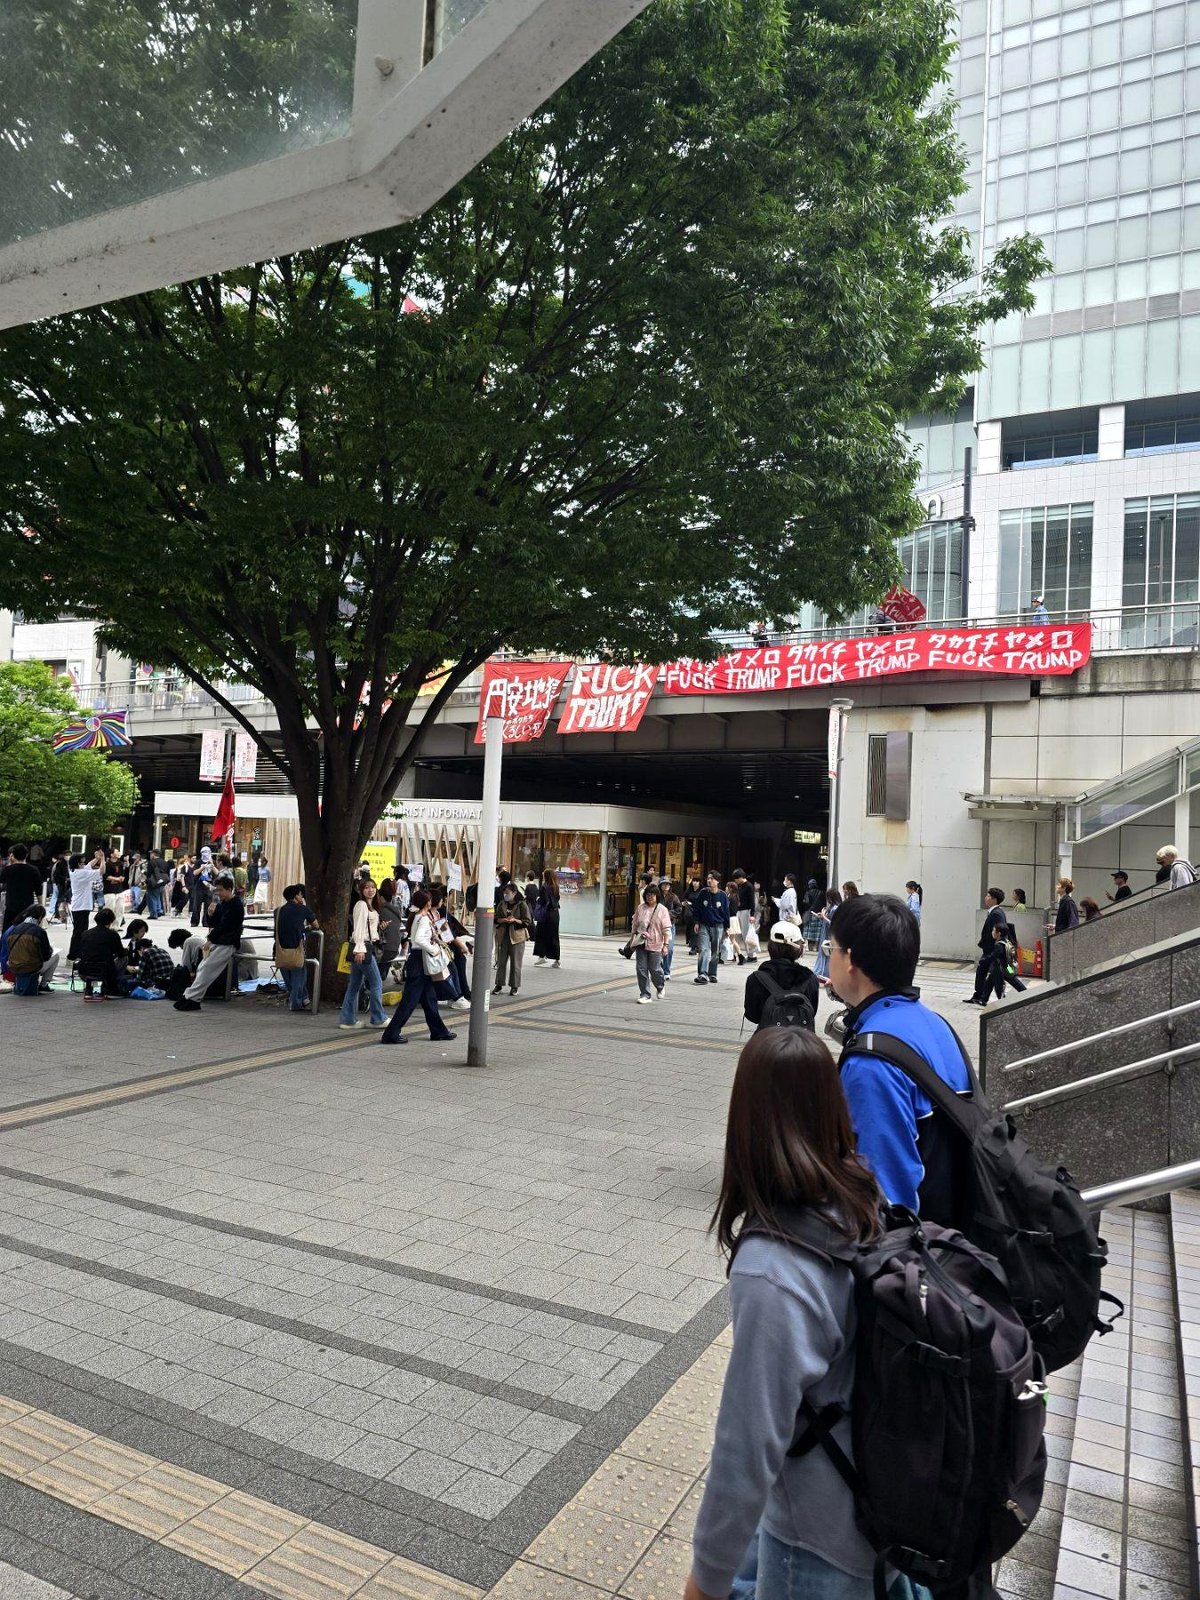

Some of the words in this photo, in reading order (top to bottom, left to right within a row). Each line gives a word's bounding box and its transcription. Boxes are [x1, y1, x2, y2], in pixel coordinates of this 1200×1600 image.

[725, 650, 781, 669] ヤメロ
[787, 642, 847, 664] タカイチ
[856, 638, 915, 660] ヤメロ
[928, 632, 998, 652] タカイチ
[1004, 630, 1073, 650] ヤメロ
[572, 664, 654, 697] FUCK
[667, 670, 717, 690] FUCK
[725, 667, 781, 690] TRUMP
[787, 661, 847, 689] FUCK
[855, 652, 920, 678] TRUMP
[928, 650, 996, 668] FUCK
[1002, 649, 1083, 671] TRUMP
[427, 807, 503, 821] INFORMATN
